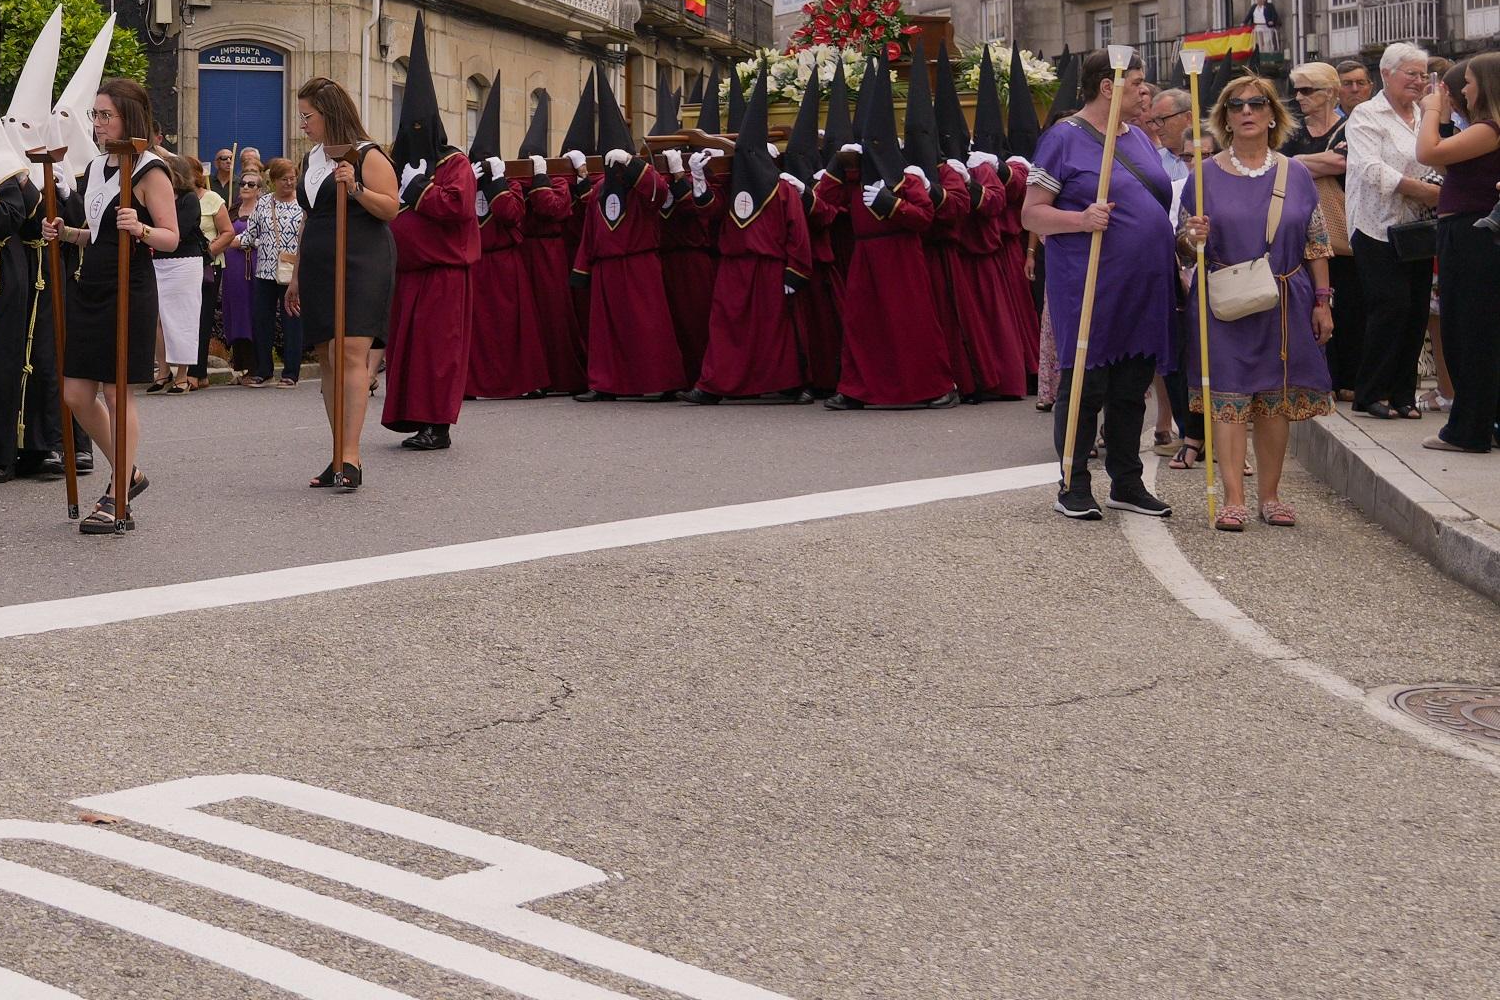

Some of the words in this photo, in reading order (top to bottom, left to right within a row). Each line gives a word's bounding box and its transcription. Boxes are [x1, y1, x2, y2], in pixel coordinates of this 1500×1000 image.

[220, 46, 260, 56] IMPRENTA
[209, 55, 232, 63] CASA
[234, 56, 272, 65] BACELAR
